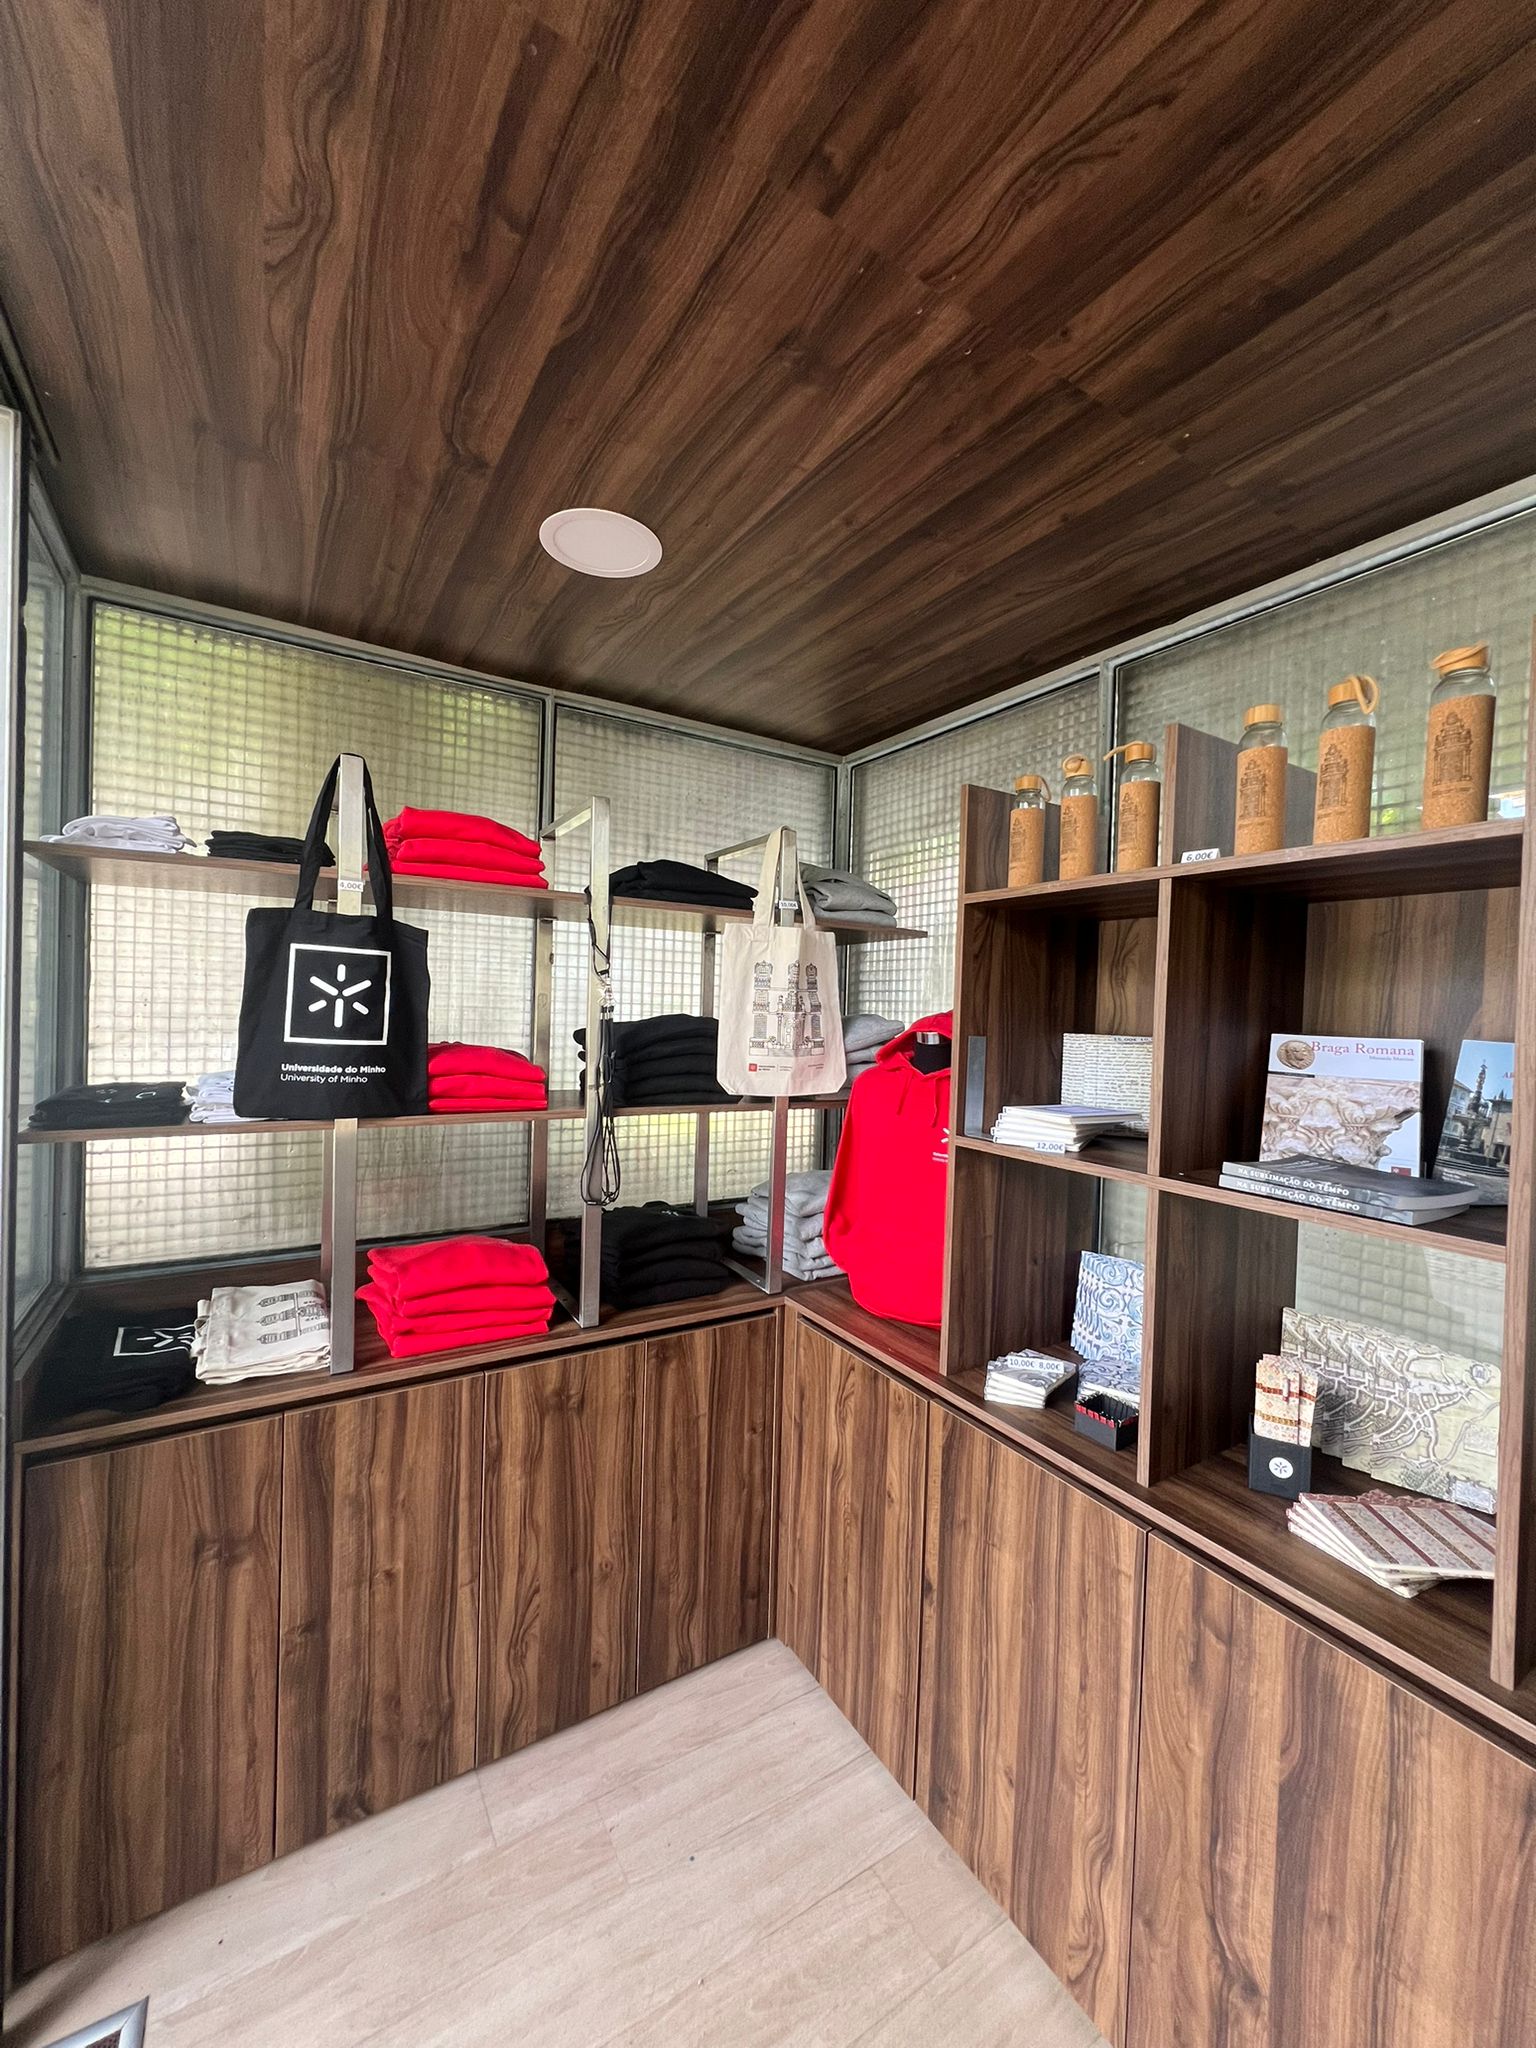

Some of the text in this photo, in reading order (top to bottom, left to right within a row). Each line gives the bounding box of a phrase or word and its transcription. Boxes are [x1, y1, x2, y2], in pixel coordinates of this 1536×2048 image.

[1186, 851, 1214, 861] 6,00€
[1311, 1041, 1415, 1056] Braga Romana
[281, 1063, 387, 1074] Universidade do Minho
[280, 1073, 368, 1084] University of Minho
[1036, 1142, 1064, 1151] 12,00€
[1237, 1167, 1248, 1176] NA
[1249, 1170, 1301, 1187] SUBLIMAÇÃO
[1302, 1179, 1316, 1189] DO
[1236, 1180, 1248, 1189] NA
[1249, 1183, 1306, 1201] SUBLIMAÇÃO
[1308, 1194, 1323, 1204] DO
[1009, 1358, 1061, 1371] 10,00€ 8,00€
